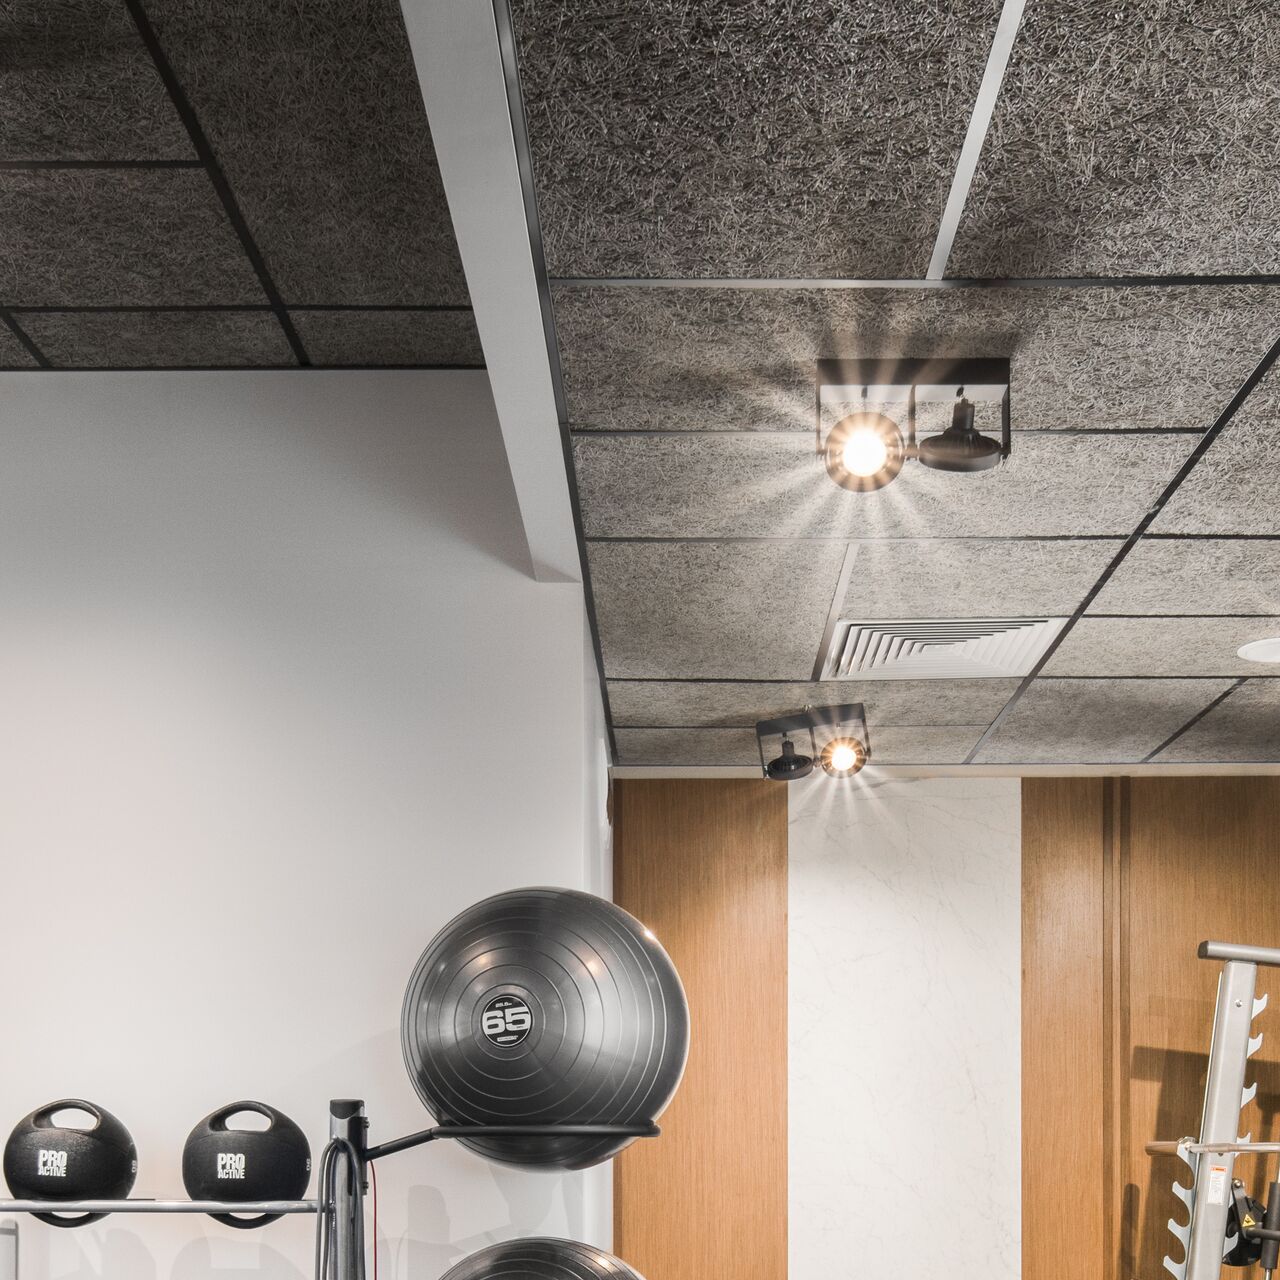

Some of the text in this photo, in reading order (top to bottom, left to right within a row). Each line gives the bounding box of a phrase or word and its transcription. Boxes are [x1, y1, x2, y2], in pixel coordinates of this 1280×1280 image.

[482, 1006, 531, 1035] 65
[38, 1149, 68, 1168] PRO
[217, 1153, 245, 1172] PRO
[37, 1166, 67, 1177] ACTIVE
[217, 1169, 245, 1179] ACTIVE
